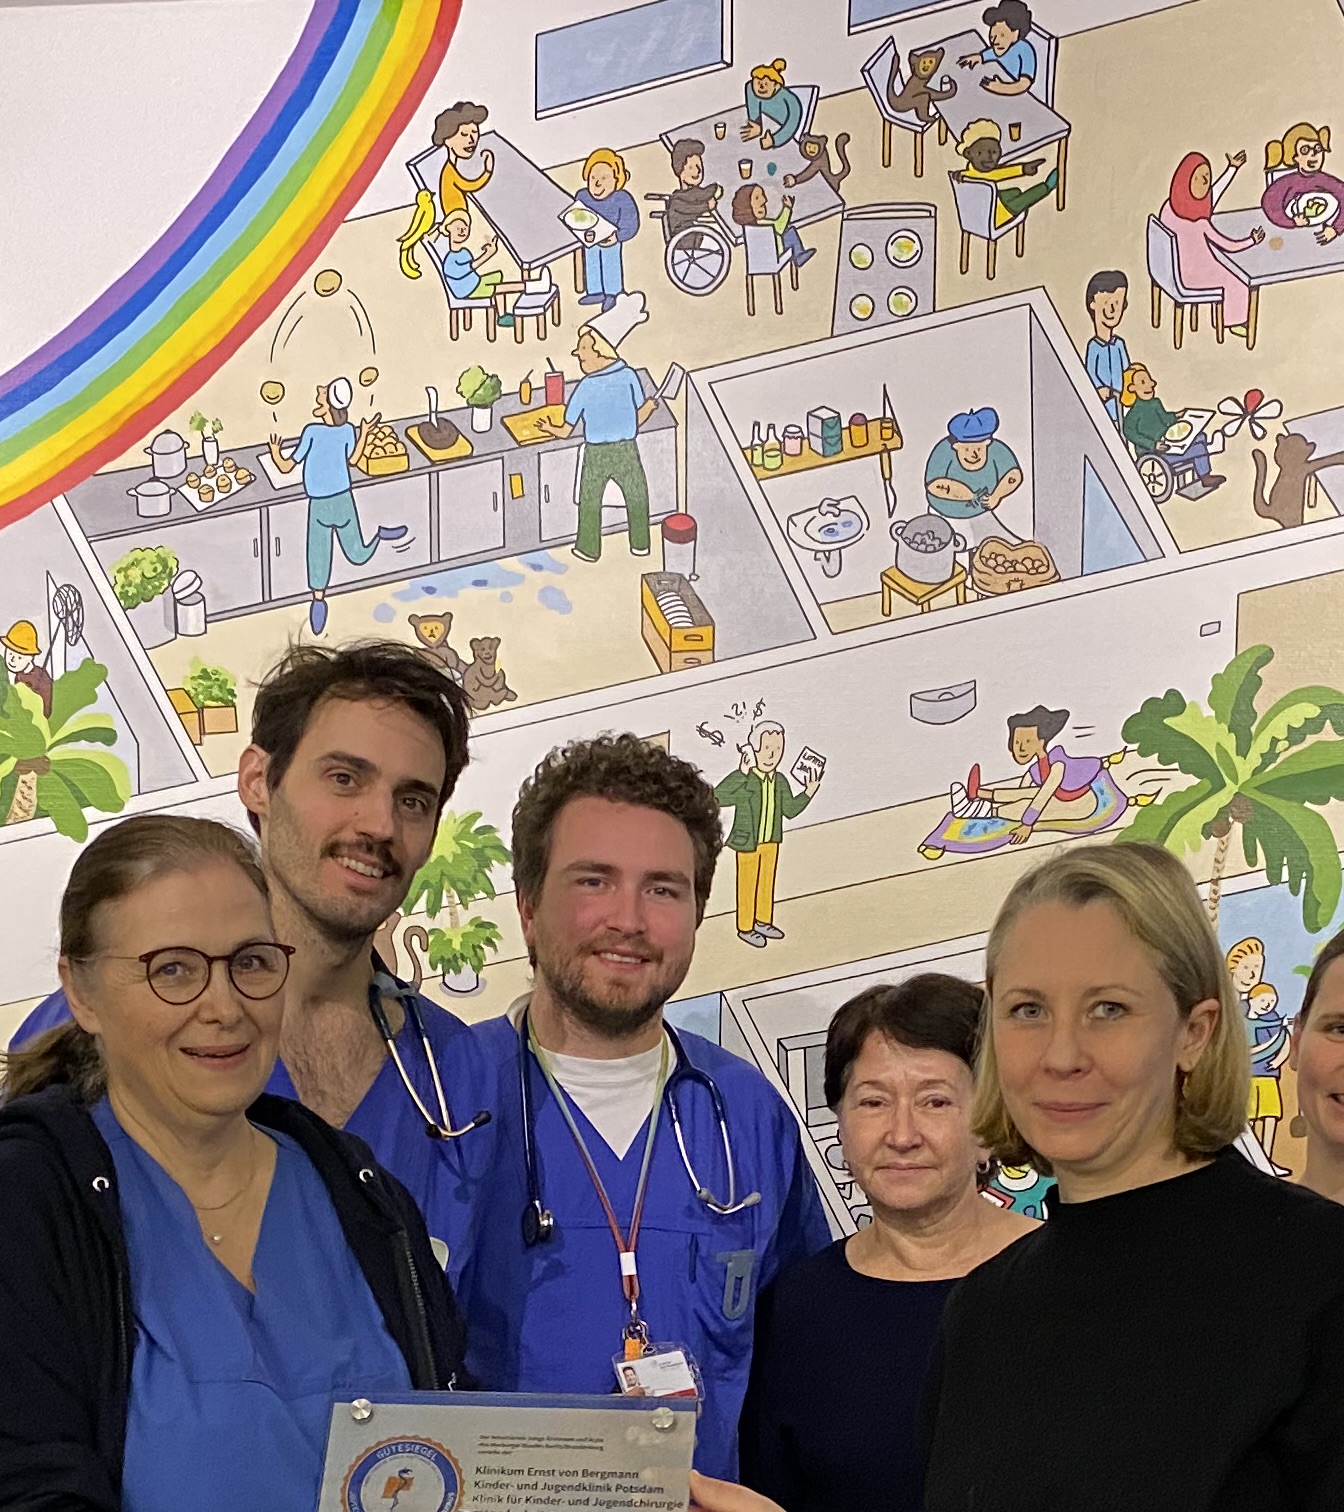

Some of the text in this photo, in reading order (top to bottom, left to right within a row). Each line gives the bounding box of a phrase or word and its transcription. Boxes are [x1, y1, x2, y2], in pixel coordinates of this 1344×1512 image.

[475, 1466, 639, 1480] Klinikum Ernst von Bergmann
[473, 1480, 664, 1494] Kinder- und Jugendklinik Potsdam
[472, 1494, 684, 1511] Klinik für Kinder- und Jugendchirurgie
